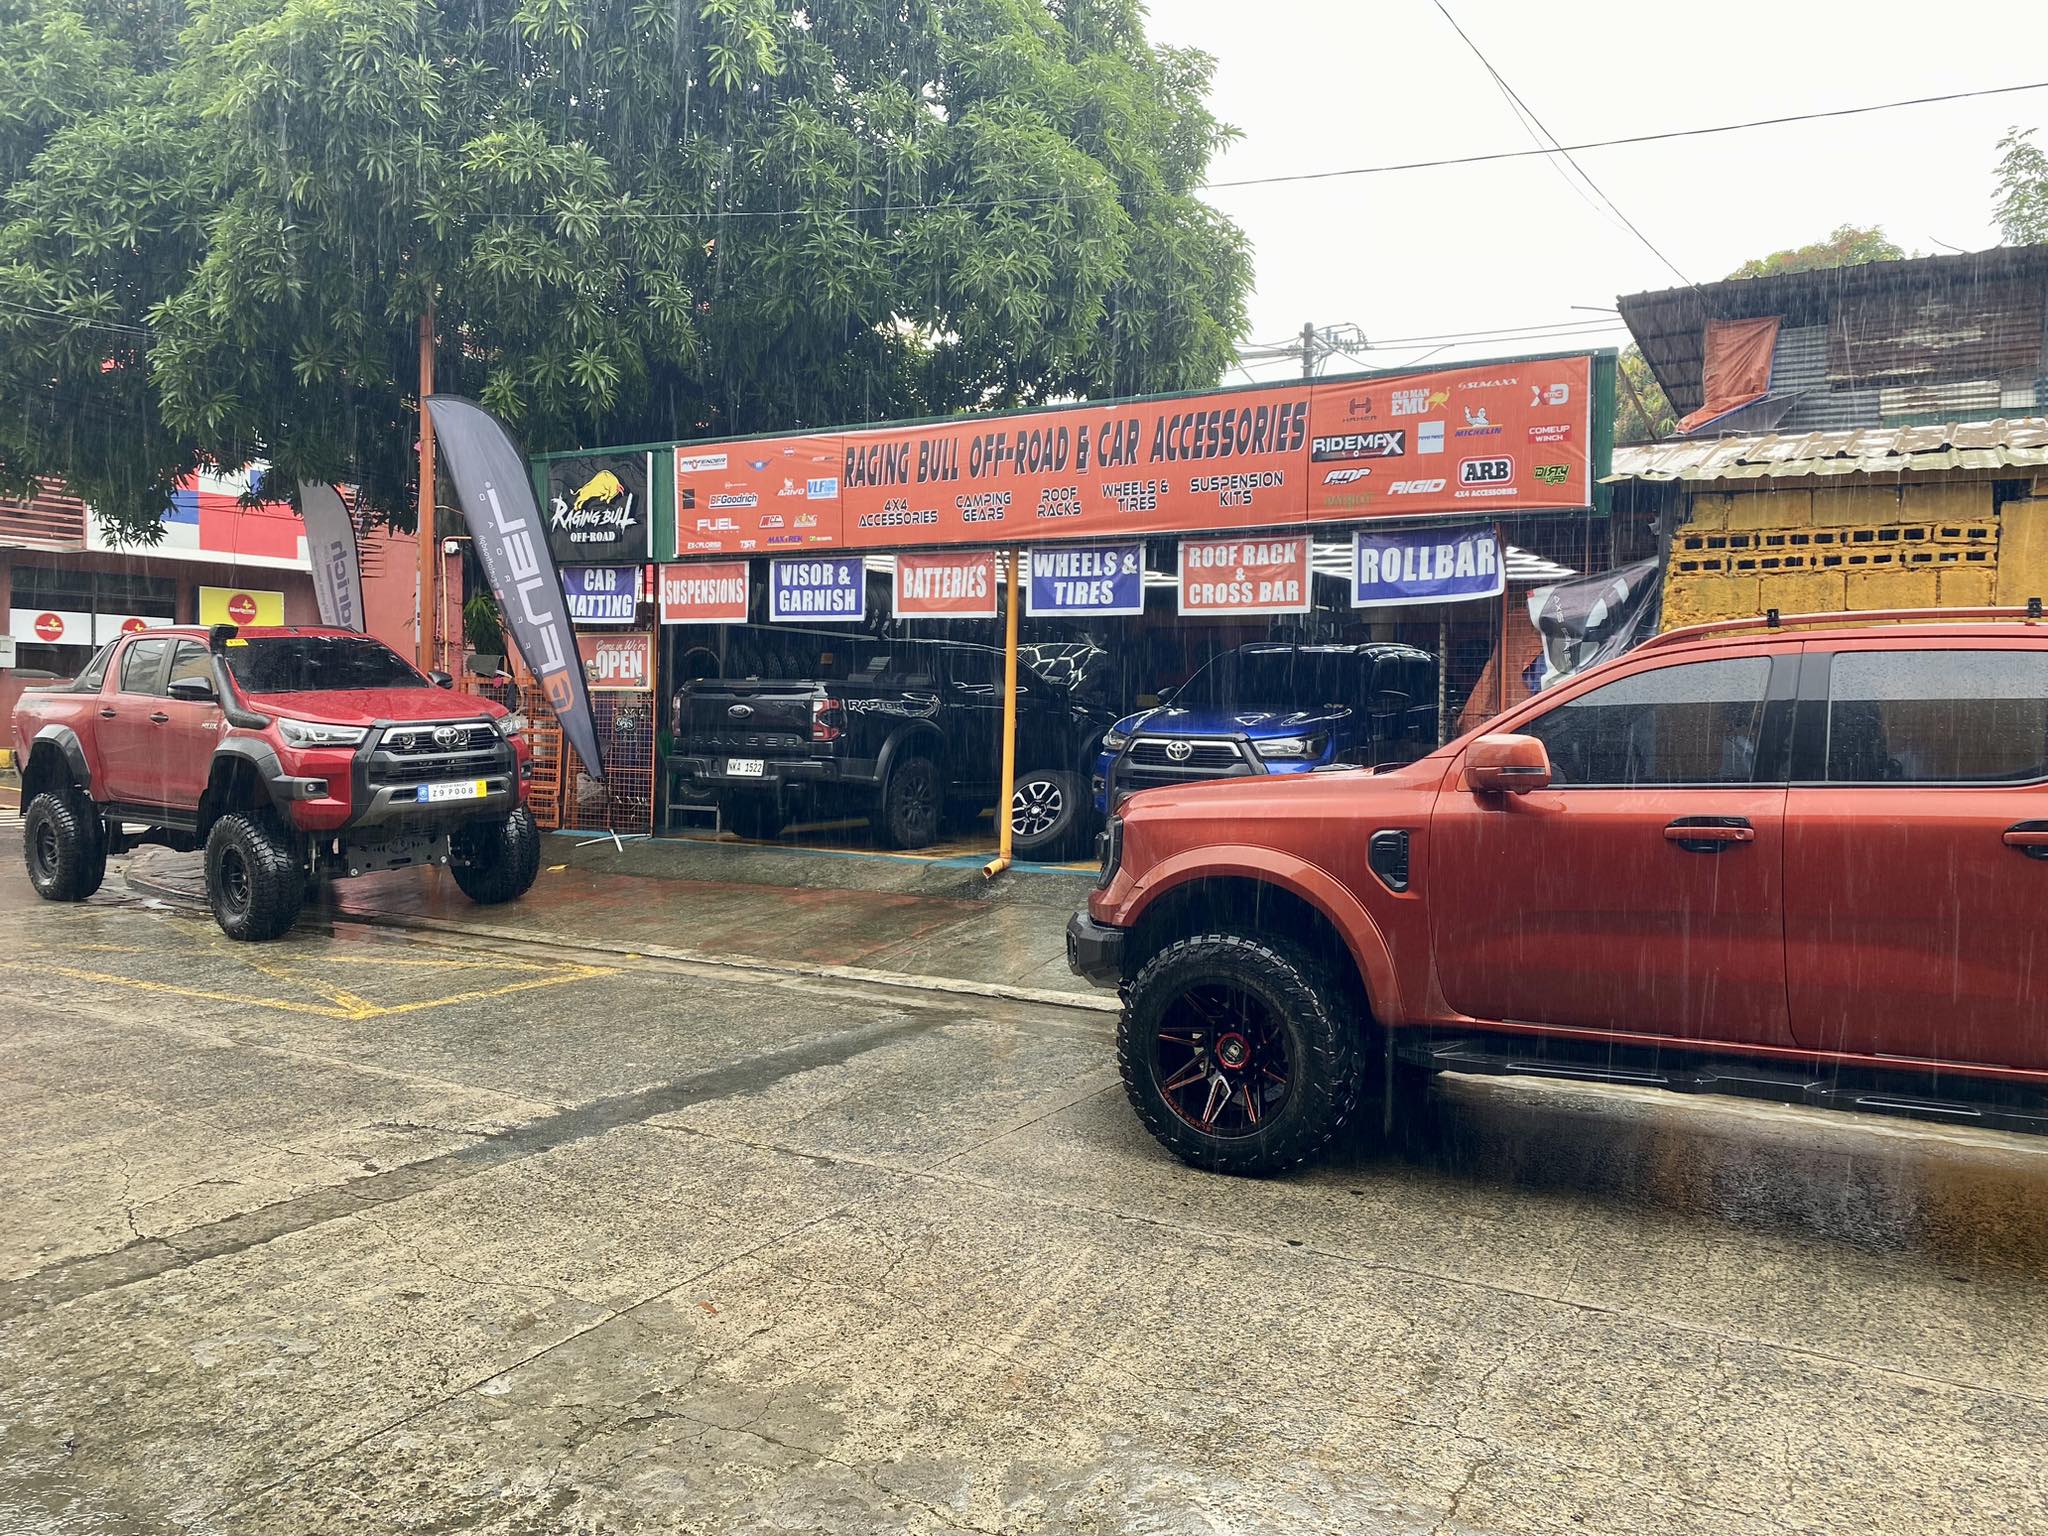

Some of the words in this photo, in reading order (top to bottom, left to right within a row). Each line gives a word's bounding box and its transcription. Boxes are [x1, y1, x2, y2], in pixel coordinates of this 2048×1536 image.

[1392, 391, 1409, 399] OLD
[1409, 388, 1430, 398] MAN
[1392, 398, 1430, 416] EMU
[1455, 427, 1502, 437] MICHELIN
[1528, 425, 1570, 436] COMEUP
[1535, 435, 1564, 443] WINCH
[844, 441, 910, 488] RAGING
[917, 438, 959, 483] BULL
[970, 426, 1069, 479] OFF-ROAD
[1076, 425, 1090, 475] &
[1097, 418, 1140, 468] CAR
[1149, 401, 1310, 464] ACCESSORIES
[1313, 431, 1404, 455] RIDEMAX
[1464, 461, 1509, 481] ARB
[1102, 480, 1156, 498] WHEELS
[1161, 479, 1169, 493] &
[1189, 471, 1284, 493] SUSPENSION
[1387, 479, 1447, 495] RIGID
[711, 492, 757, 505] BFGoodrich
[955, 491, 1012, 509] CAMPING
[1041, 487, 1077, 502] ROOF
[1219, 490, 1252, 507] KITS
[1454, 490, 1470, 498] 4X4
[1471, 488, 1518, 497] ACCESSORIES
[884, 499, 908, 511] 4X4
[1037, 501, 1081, 518] RACKS
[1117, 496, 1157, 512] TIRES
[551, 493, 601, 532] RAGING
[601, 493, 637, 534] BULL
[858, 511, 938, 528] ACCESSORIES
[962, 506, 1004, 523] GEARS
[697, 518, 740, 531] FUEL
[570, 531, 616, 542] OFF-ROAD
[1188, 545, 1237, 567] ROOF
[1243, 542, 1297, 565] RACK
[1361, 538, 1496, 584] ROLLBAR
[1034, 552, 1118, 577] WHEELS
[1122, 553, 1137, 575] &
[583, 569, 616, 591] CAR
[781, 563, 833, 586] VISOR
[838, 566, 851, 585] &
[903, 565, 987, 598] BATTERIES
[1236, 567, 1246, 581] &
[666, 578, 744, 605] SUSPENSIONS
[1054, 580, 1114, 605] TIRES
[1189, 583, 1253, 604] CROSS
[1259, 580, 1299, 602] BAR
[779, 589, 856, 612] GARNISH
[596, 650, 642, 679] OPEN
[849, 700, 902, 714] RAPTOR
[745, 763, 762, 772] 1522
